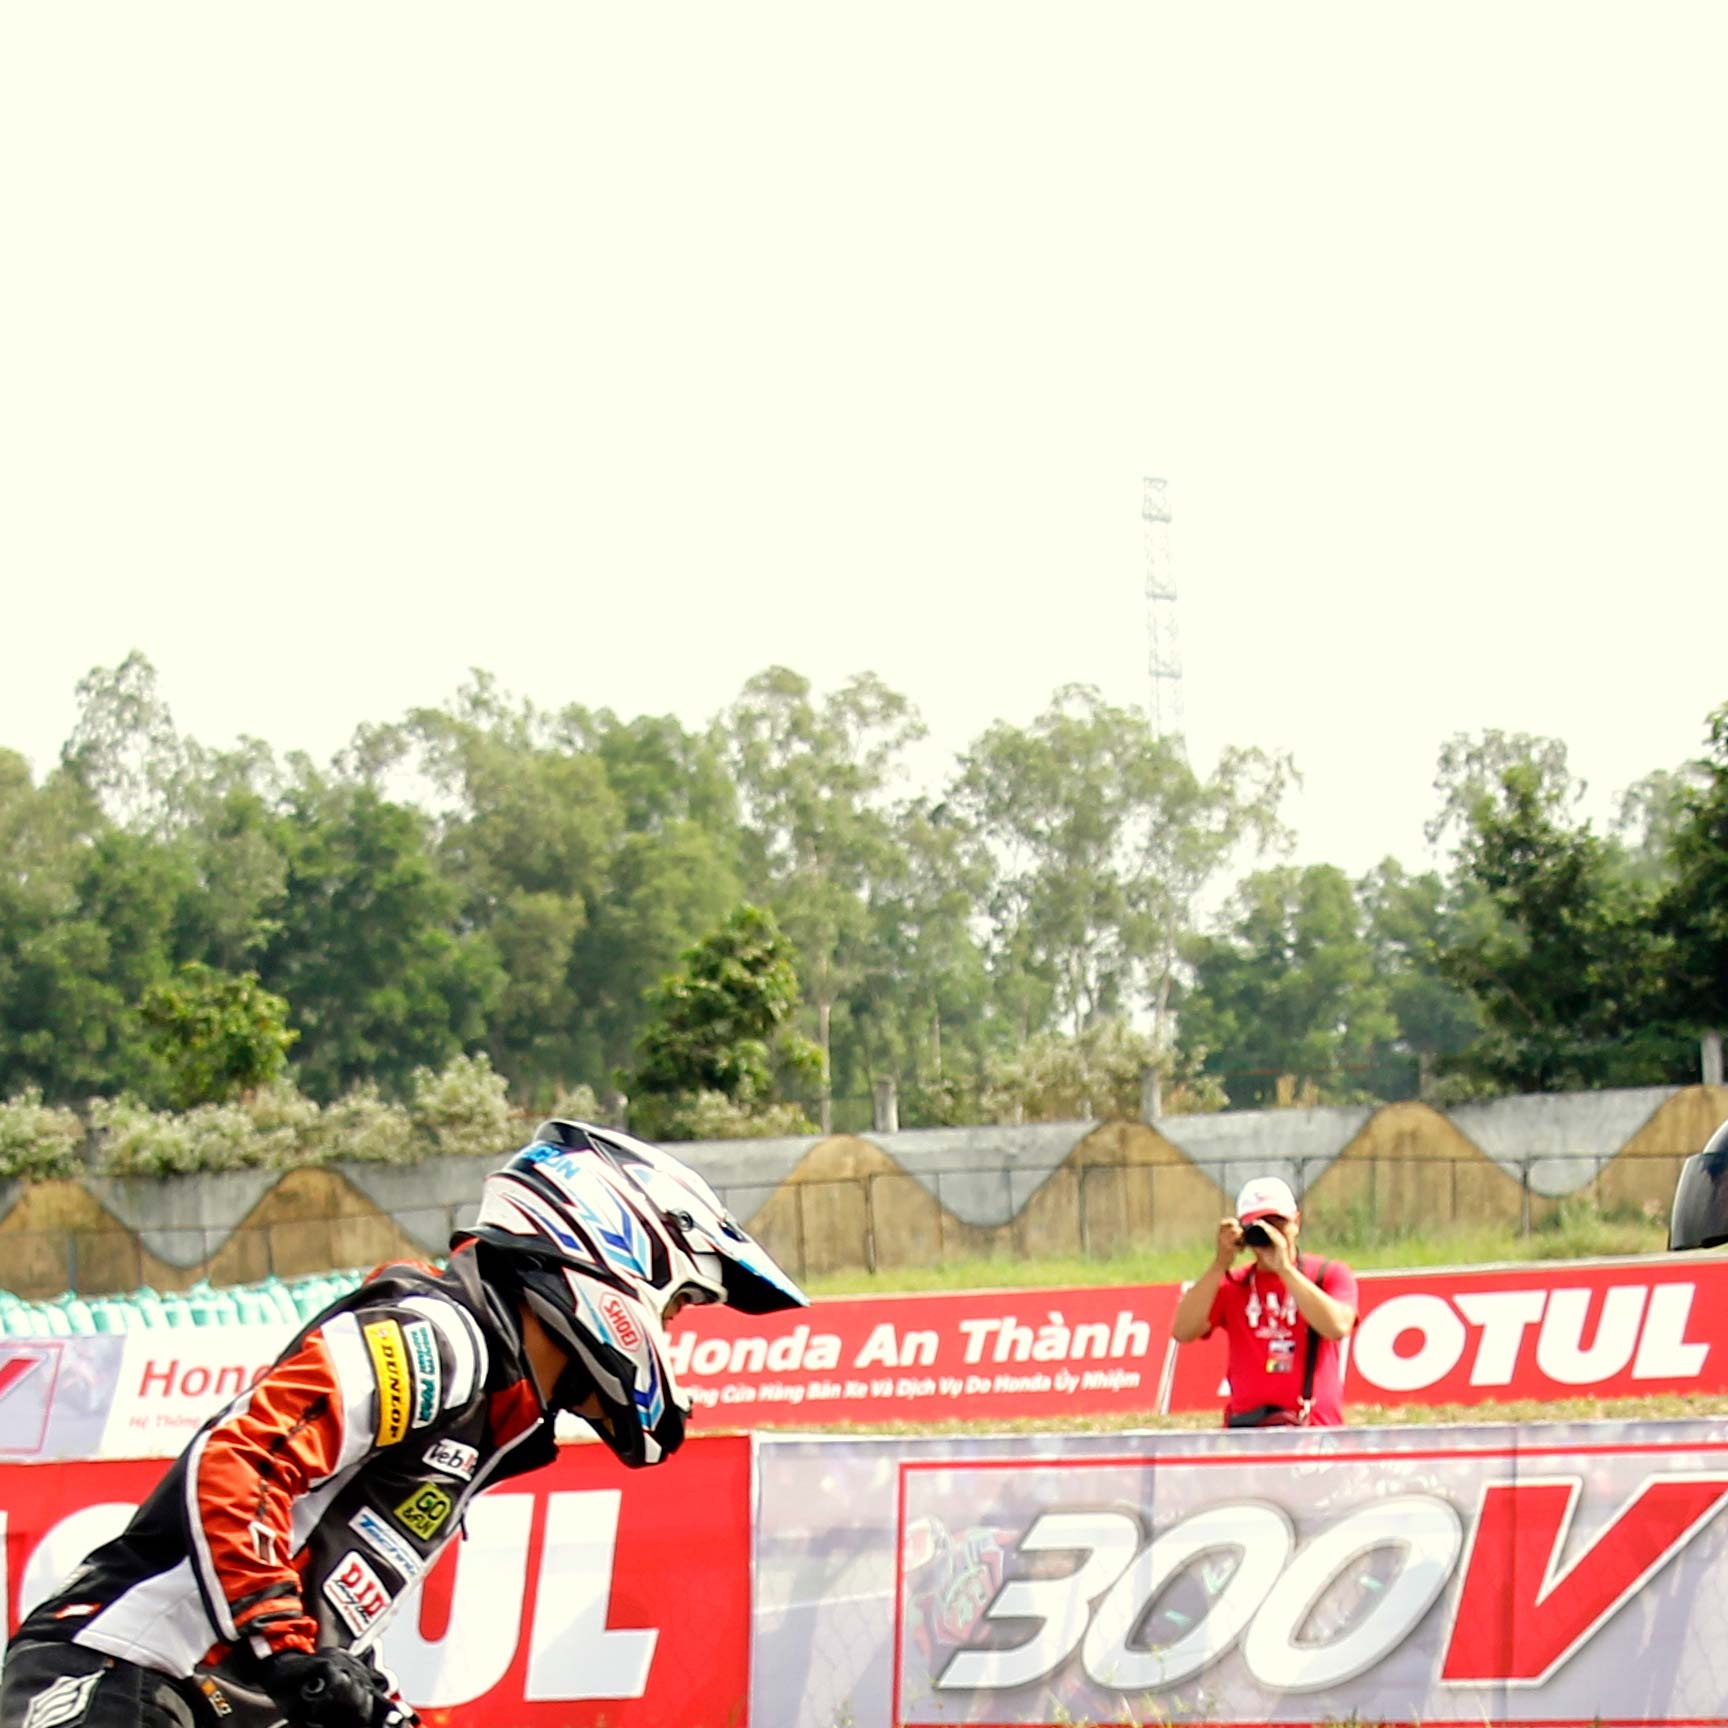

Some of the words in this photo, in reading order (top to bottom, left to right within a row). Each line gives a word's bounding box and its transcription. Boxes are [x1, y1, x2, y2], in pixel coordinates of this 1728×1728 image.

[604, 1299, 639, 1347] SHOEI
[664, 1324, 842, 1376] Honda
[853, 1323, 939, 1368] An
[959, 1311, 1151, 1364] Thành
[1217, 1282, 1710, 1396] OTUL
[382, 1345, 401, 1438] DUNLOP
[415, 1491, 447, 1521] GO
